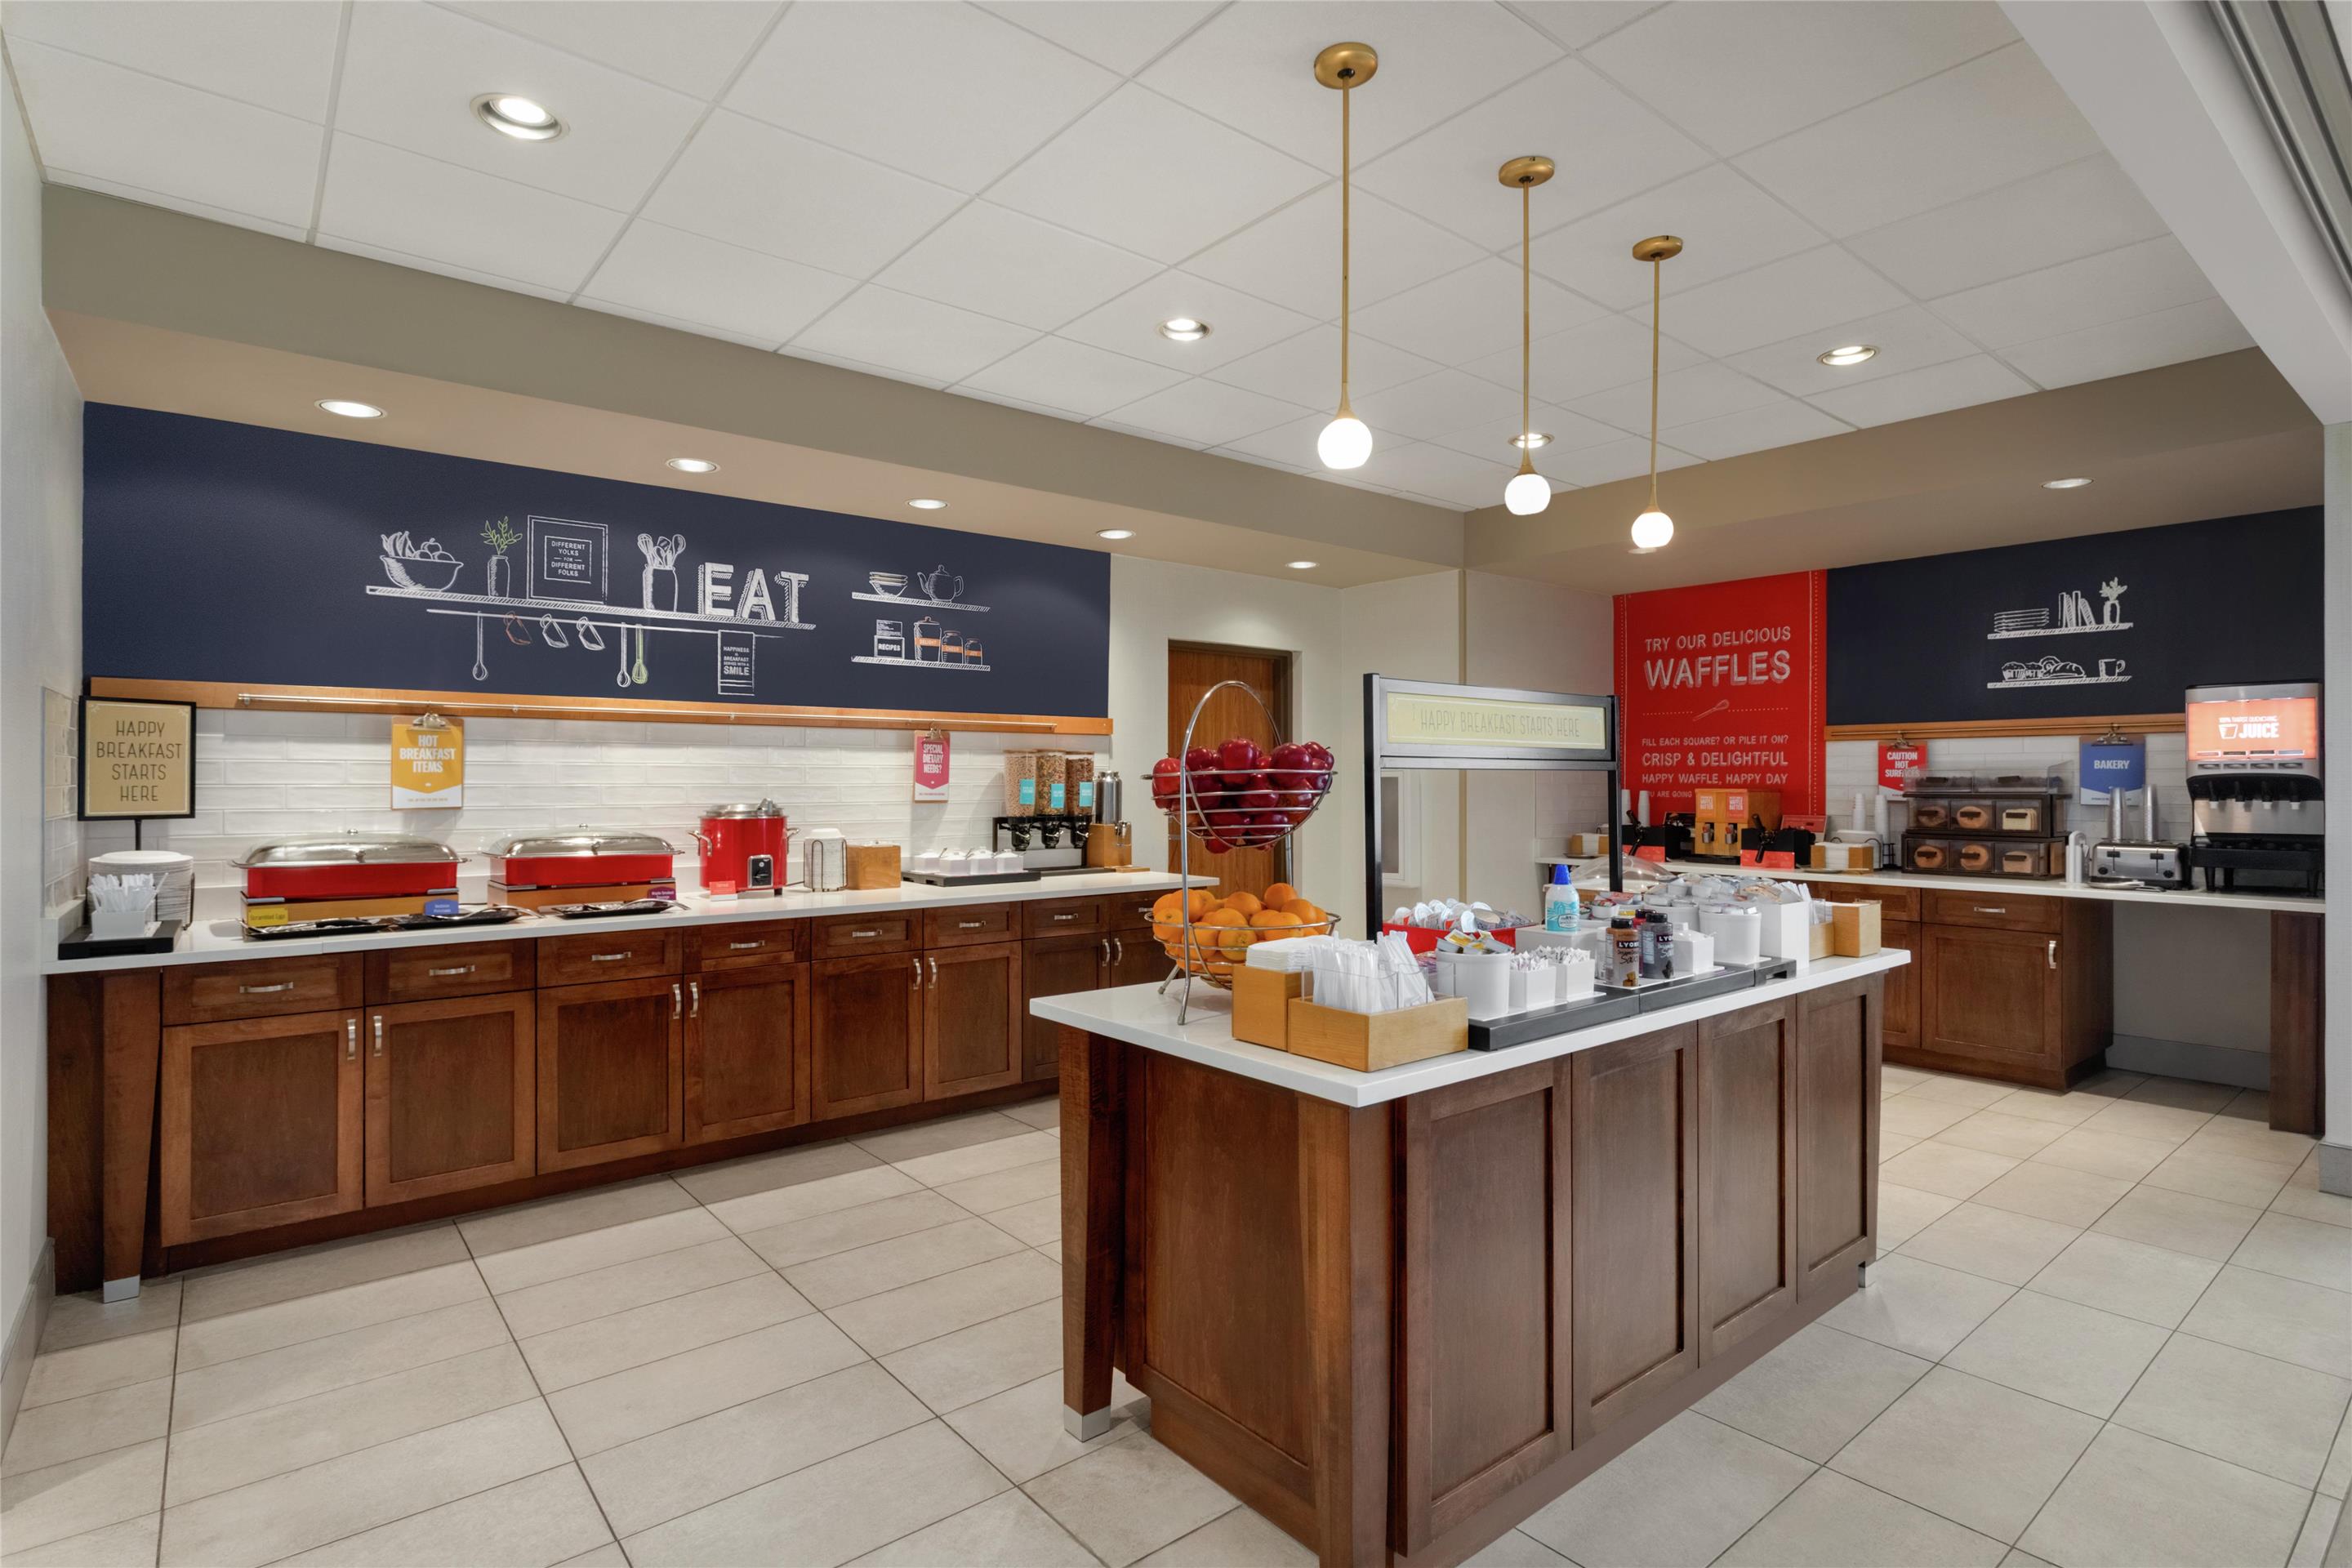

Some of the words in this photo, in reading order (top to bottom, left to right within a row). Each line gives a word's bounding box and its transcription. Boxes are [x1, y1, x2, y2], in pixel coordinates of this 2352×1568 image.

[551, 541, 586, 550] DIFFERENT
[551, 561, 586, 571] DIFFERENT
[698, 562, 809, 623] EAT
[1645, 637, 1671, 653] TRY
[1677, 634, 1707, 649] OUR
[1713, 626, 1791, 647] DELICIOUS
[878, 643, 901, 652] RECIPES
[723, 665, 751, 675] SMILE
[1644, 649, 1791, 691] WAFFLES
[116, 720, 165, 737] HAPPY
[1421, 709, 1455, 733] HAPPY
[1460, 711, 1517, 734] BREAKFAST
[1520, 715, 1552, 737] STARTS
[1557, 718, 1580, 737] HERE
[2238, 723, 2280, 738] JUICE
[417, 735, 439, 747] HOT
[1642, 737, 1657, 746] FILL
[1659, 737, 1681, 746] EACH
[1683, 736, 1721, 746] SQUARE?
[1723, 736, 1736, 745] OR
[1738, 735, 1757, 745] PILE
[1759, 735, 1767, 744] IT
[1771, 734, 1789, 744] ON?
[96, 741, 182, 760] BREAKFAST
[399, 747, 457, 760] BREAKFAST
[923, 743, 943, 754] SPECIAL
[922, 753, 944, 764] DIETARY
[1642, 752, 1682, 767] CRISP
[1686, 752, 1695, 766] &
[1701, 751, 1789, 767] DELIGHTFUL
[1886, 751, 1918, 760] CAUTION
[412, 760, 443, 773] ITEMS
[923, 764, 942, 774] NEEDS?
[1895, 760, 1909, 769] HOT
[2093, 760, 2131, 769] BAKERY
[112, 763, 167, 781] STARTS
[1642, 773, 1674, 784] HAPPY
[1678, 773, 1722, 785] WAFFLE,
[1726, 773, 1762, 784] HAPPY
[1766, 773, 1788, 784] DAY
[120, 785, 158, 802] HERE
